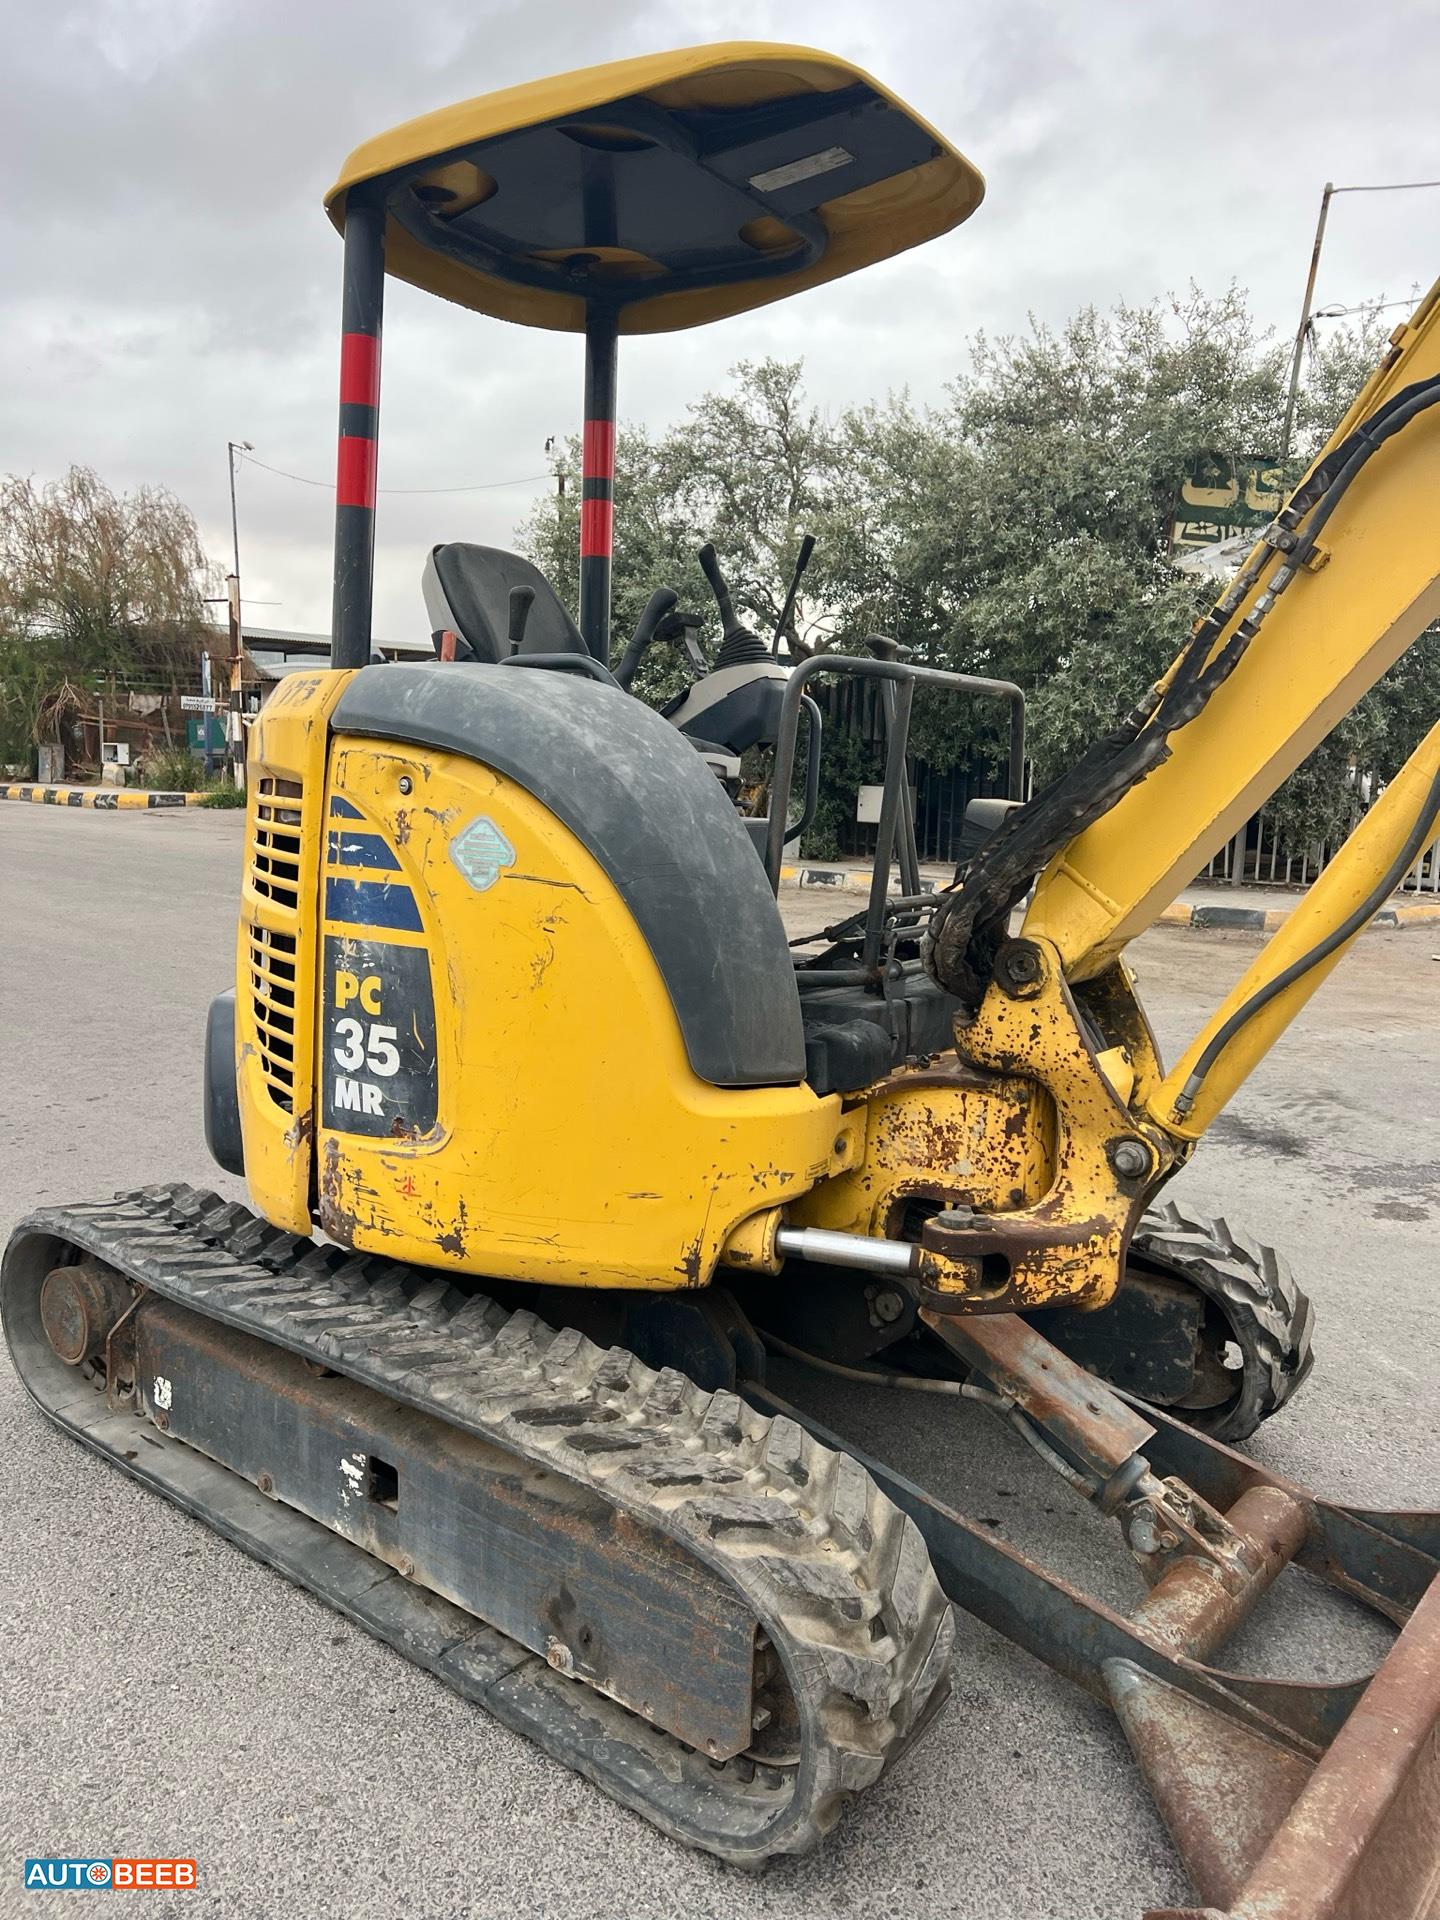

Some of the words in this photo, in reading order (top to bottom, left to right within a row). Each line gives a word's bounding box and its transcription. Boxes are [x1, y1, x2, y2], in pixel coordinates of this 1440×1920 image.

[335, 970, 382, 1015] PC
[334, 1017, 400, 1077] 35
[335, 1077, 385, 1117] MR
